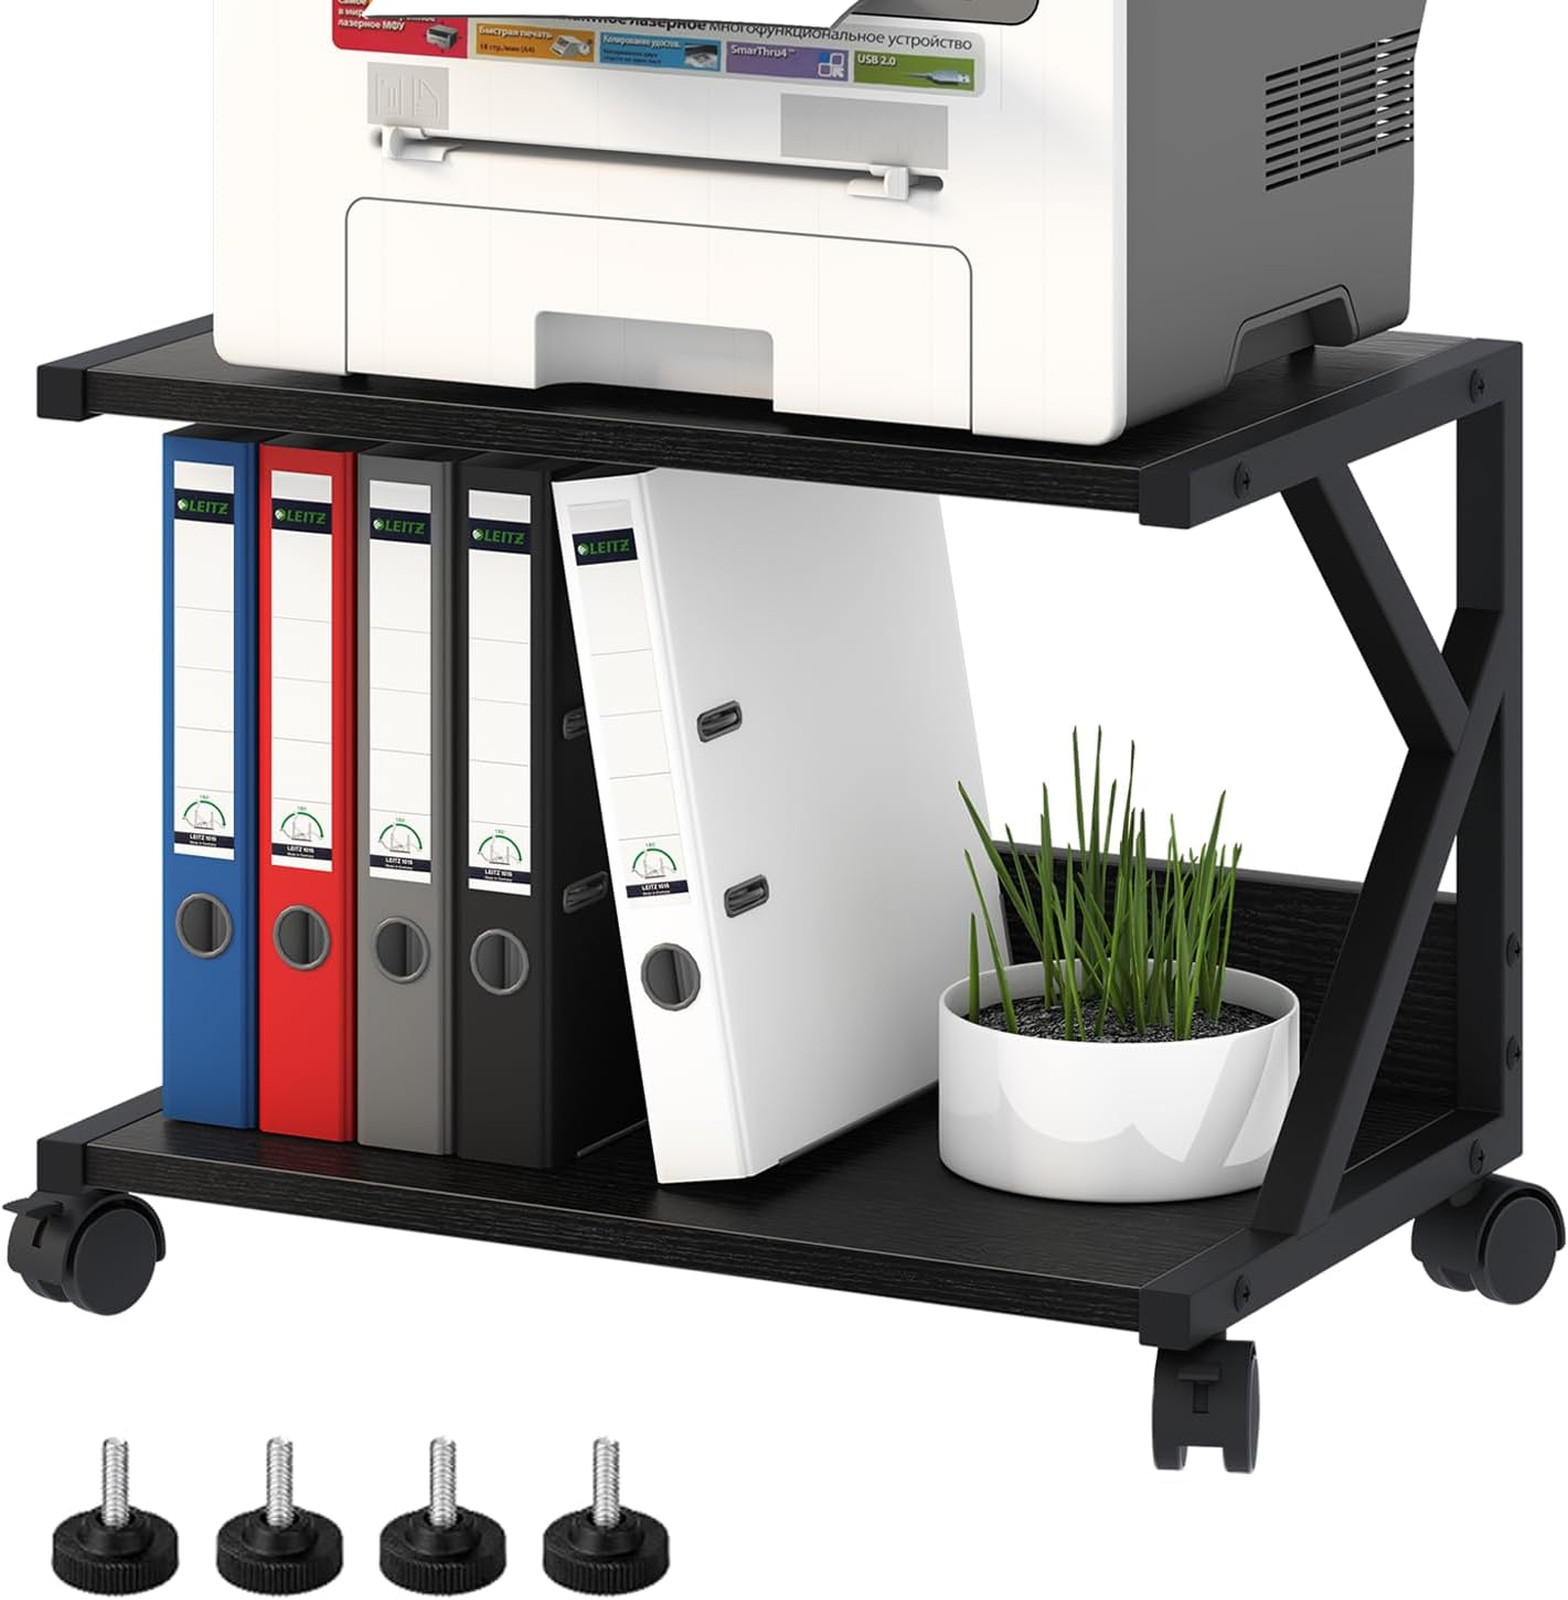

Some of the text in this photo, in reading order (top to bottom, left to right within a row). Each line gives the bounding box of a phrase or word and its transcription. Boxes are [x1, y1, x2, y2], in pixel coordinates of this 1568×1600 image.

[337, 19, 406, 31] лазерное МФУ
[479, 25, 552, 40] Быстрая печать
[709, 21, 885, 43] многофункциональное
[888, 34, 973, 50] устройство
[857, 53, 897, 66] USB 2.0
[189, 500, 229, 515] LEITZ
[286, 510, 326, 525] LEITZ
[385, 519, 425, 535] LEITZ
[484, 529, 525, 545] LEITZ
[589, 539, 630, 555] LEITZ
